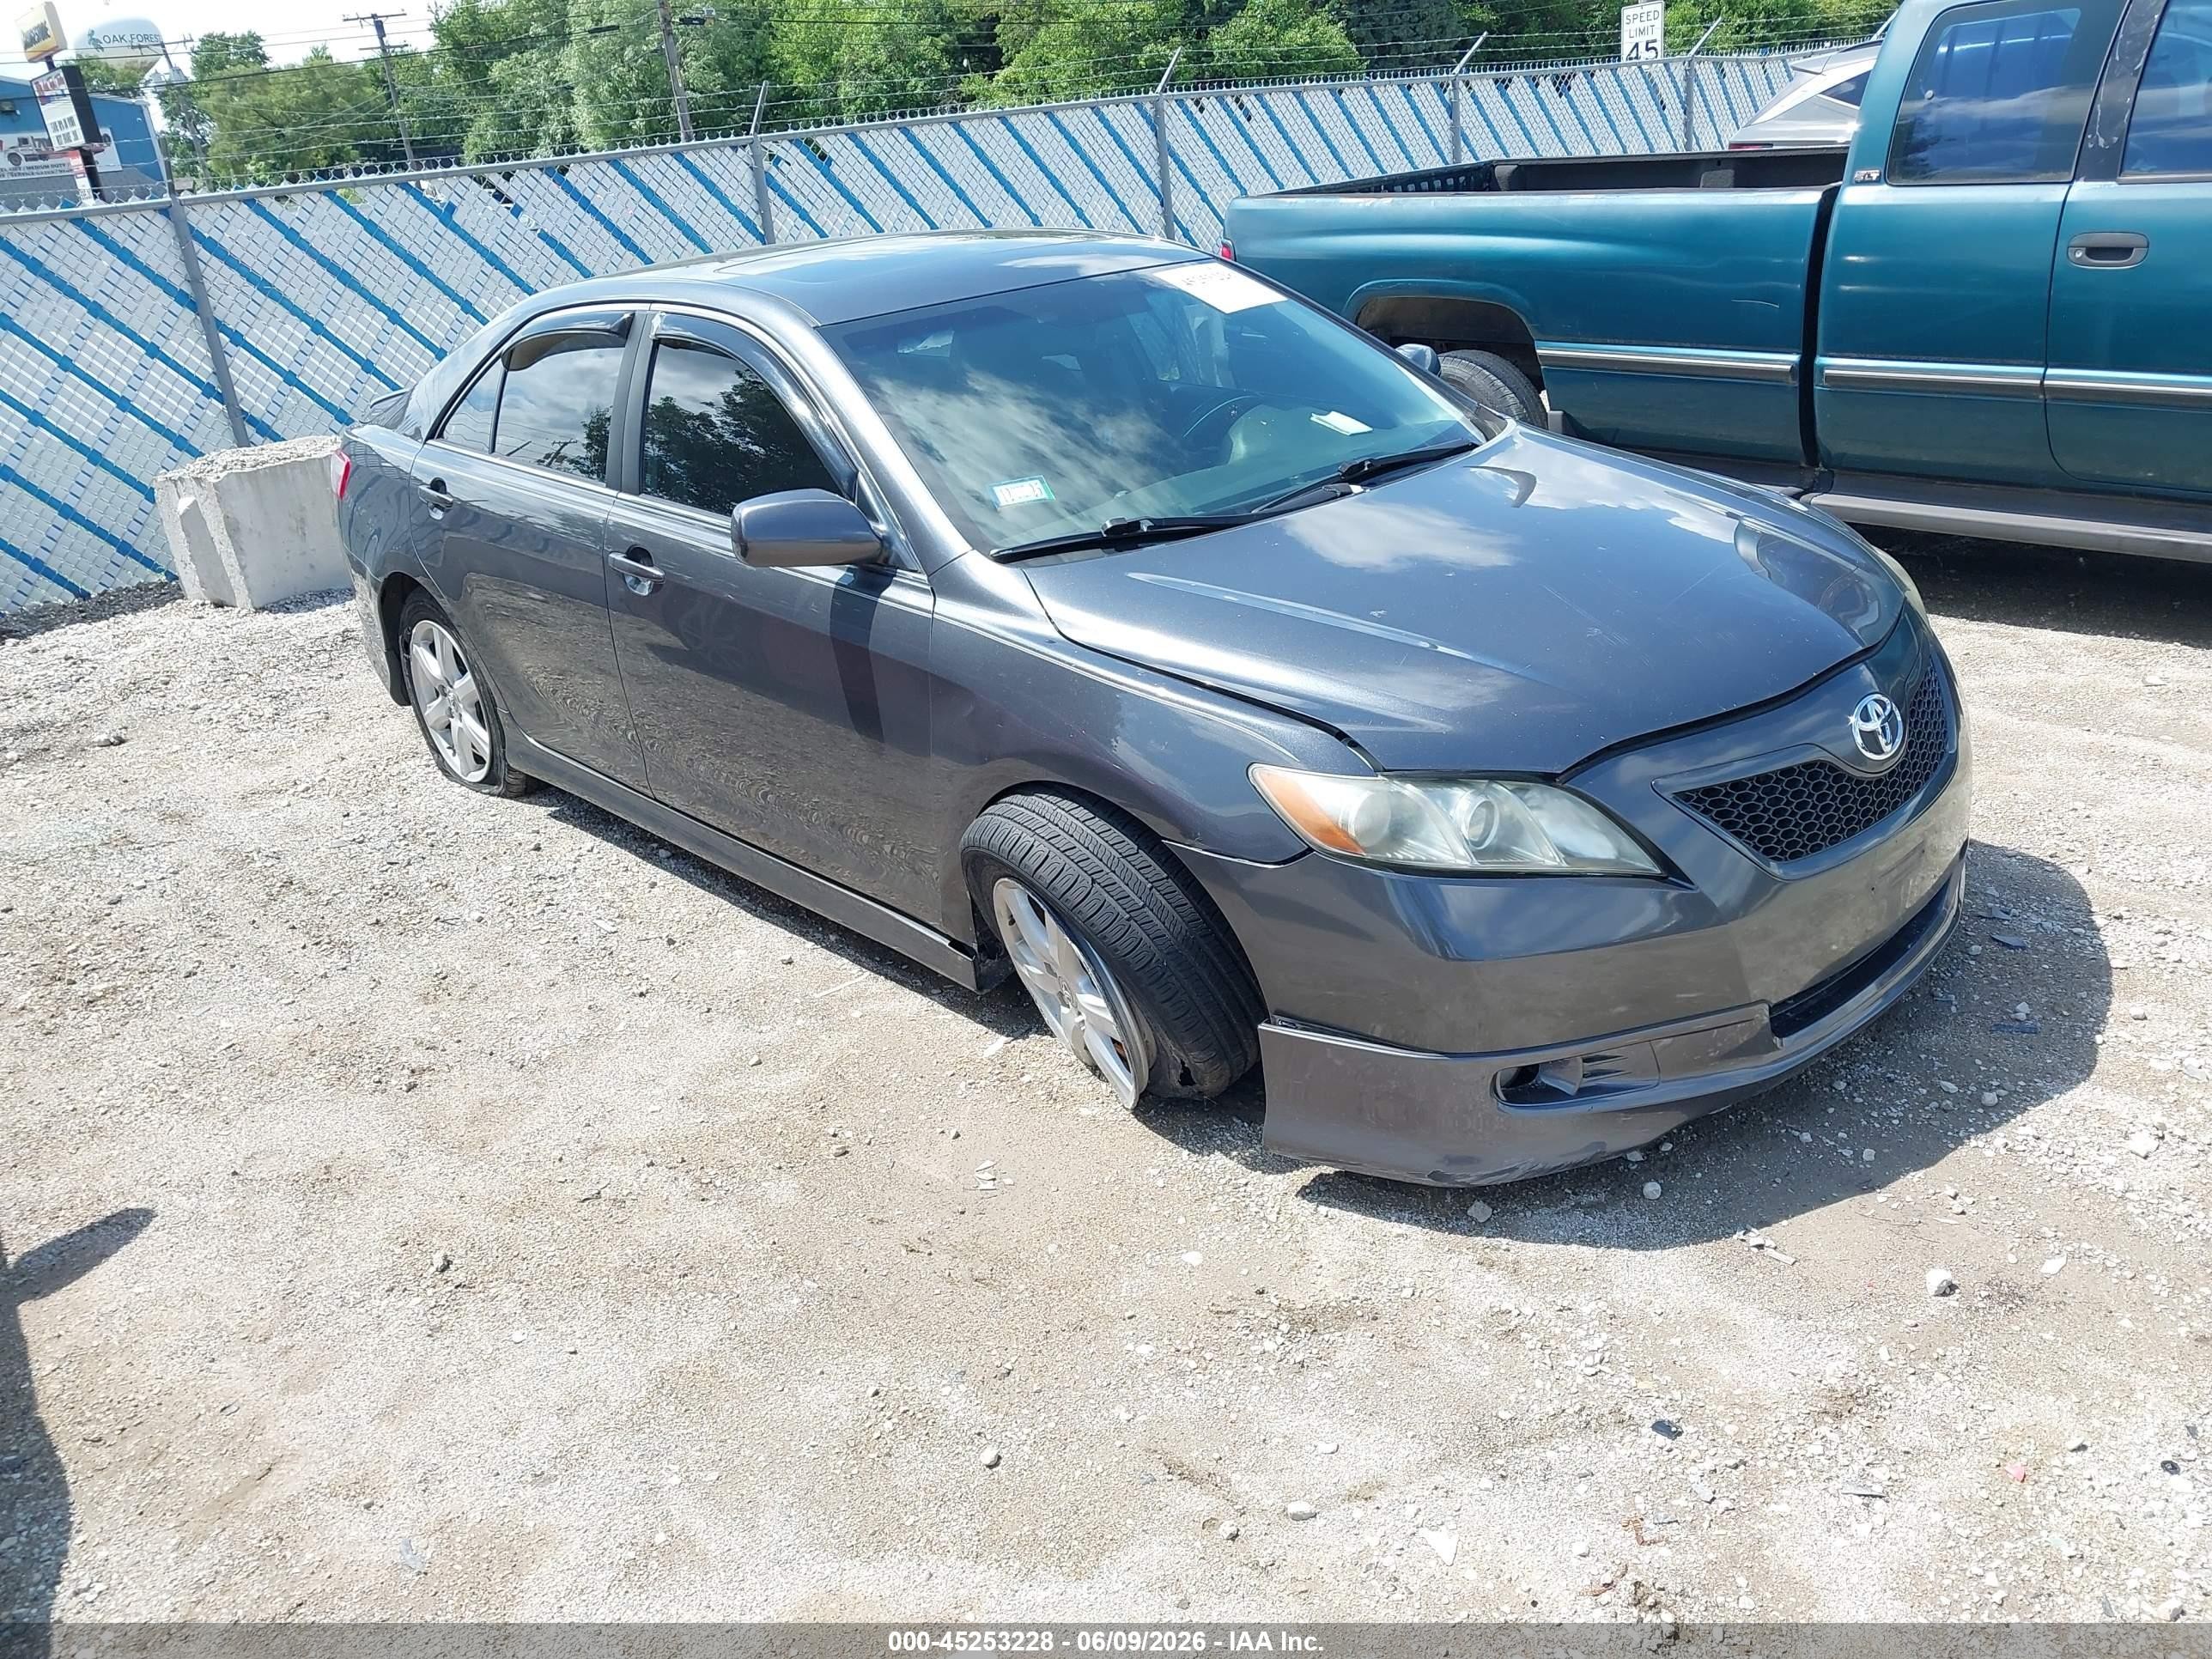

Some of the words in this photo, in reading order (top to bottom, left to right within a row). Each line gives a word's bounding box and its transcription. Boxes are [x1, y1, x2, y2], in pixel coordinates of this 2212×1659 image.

[1626, 9, 1660, 25] SPEED
[102, 34, 128, 44] OAK
[1629, 25, 1656, 39] LIMIT
[1626, 39, 1659, 61] 45
